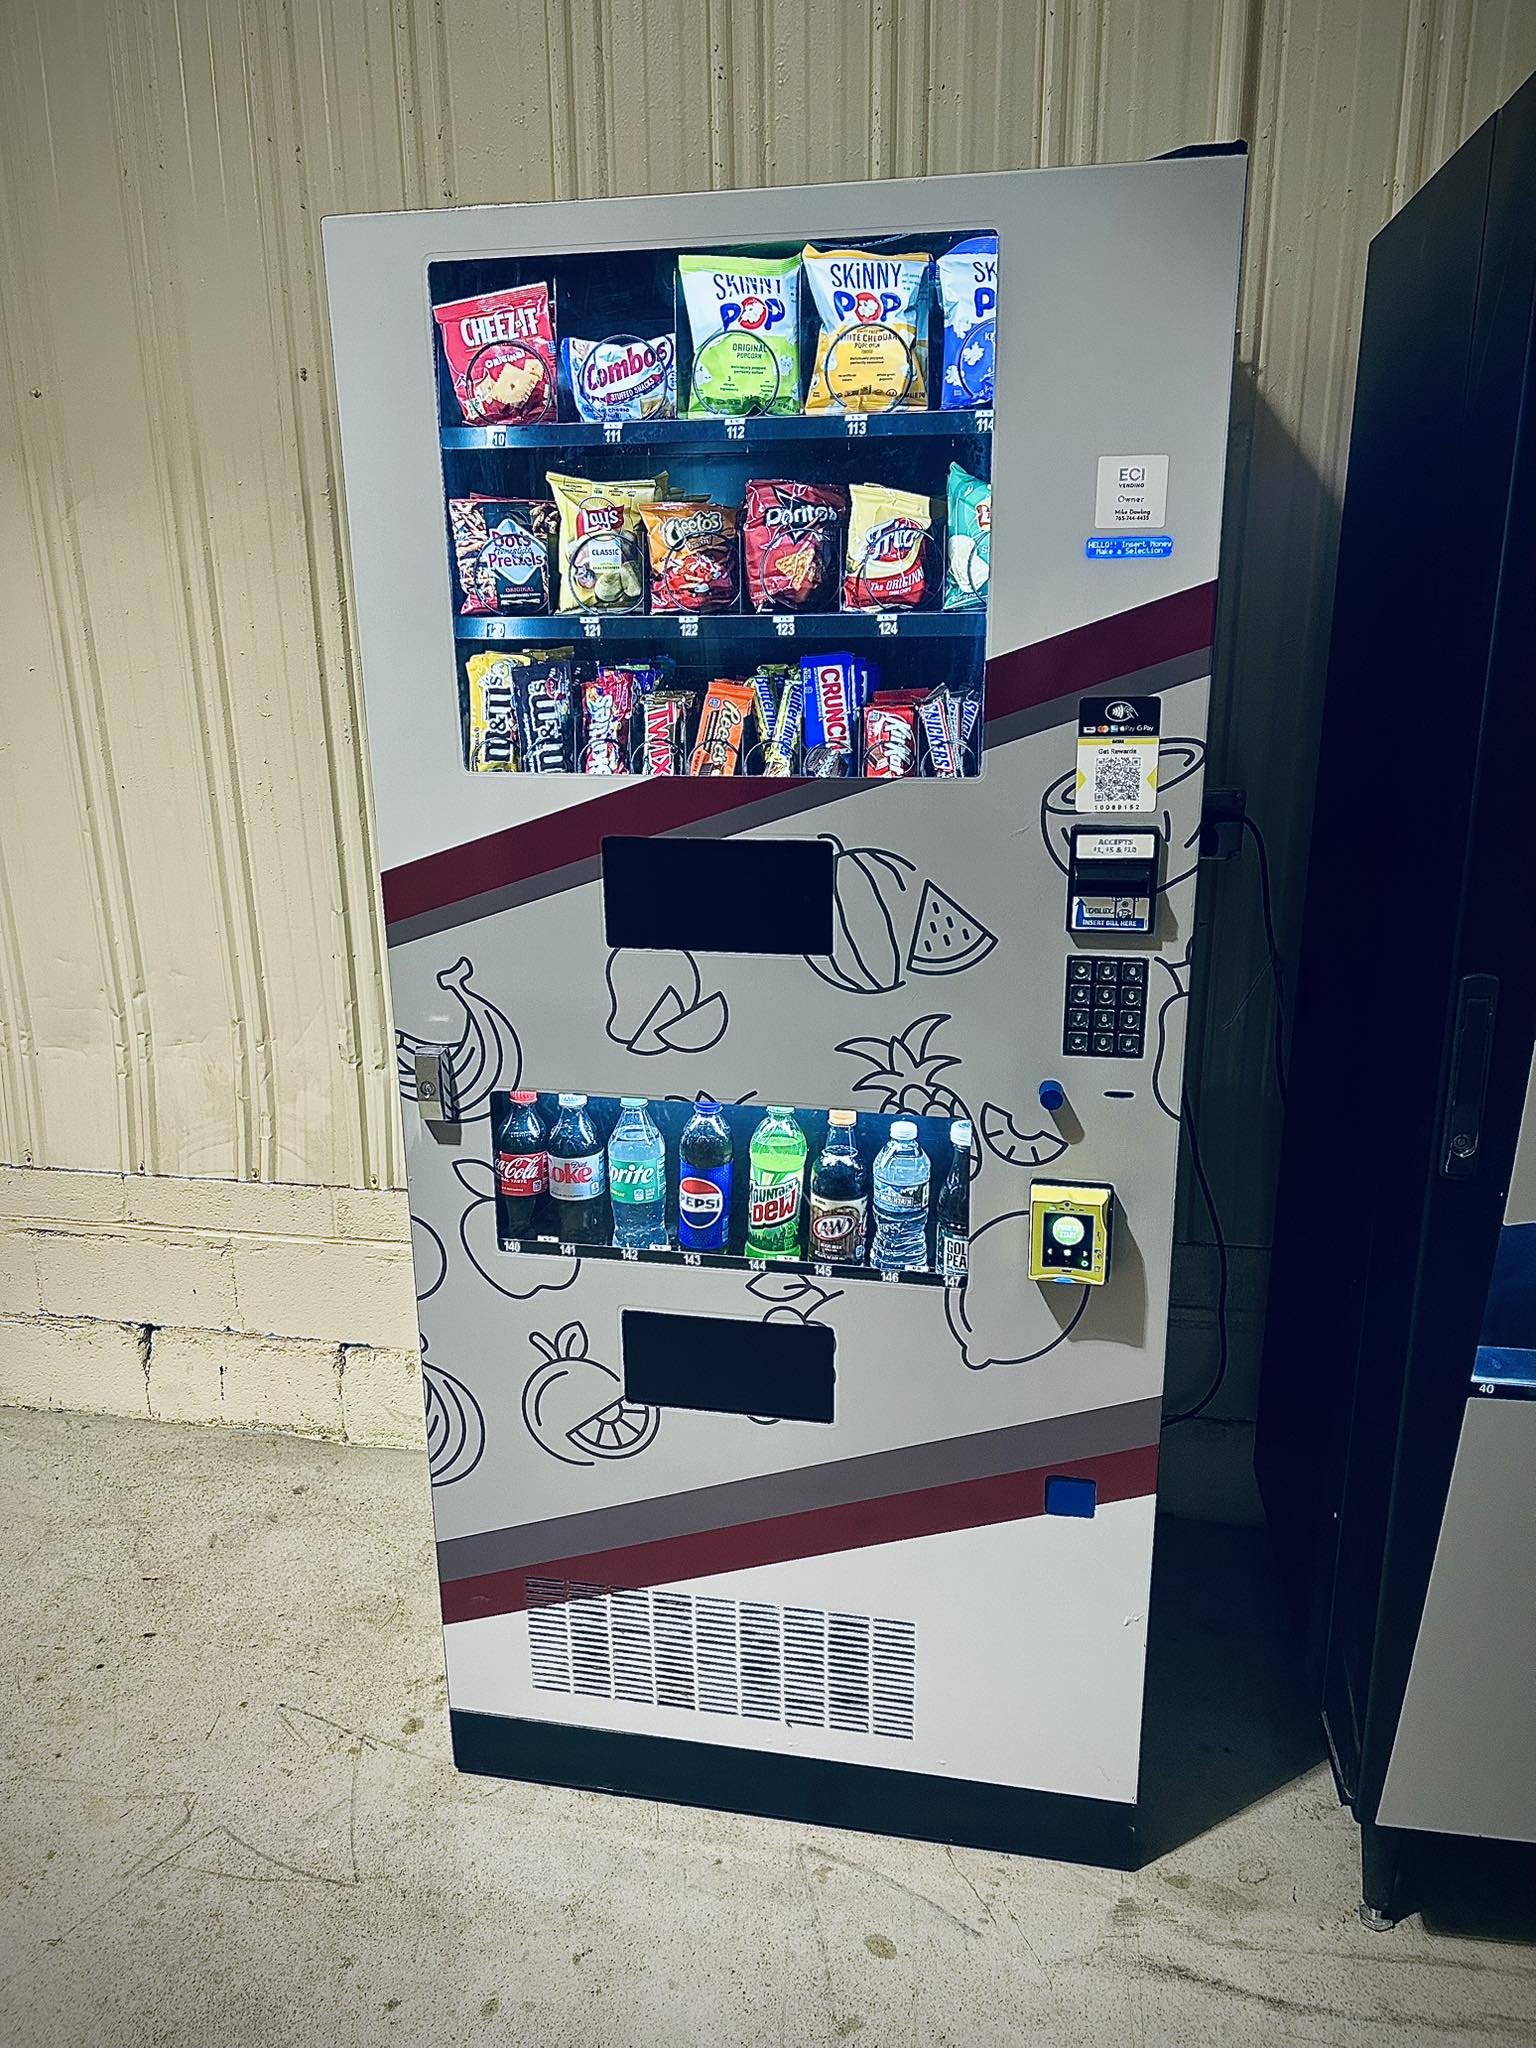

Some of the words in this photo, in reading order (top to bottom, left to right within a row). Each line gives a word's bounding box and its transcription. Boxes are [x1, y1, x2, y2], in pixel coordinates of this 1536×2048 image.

[720, 296, 786, 332] POP
[833, 291, 902, 324] POP
[732, 343, 768, 352] ORIGINAL
[587, 341, 668, 391] Combos
[610, 389, 634, 402] STUFFED
[726, 425, 745, 439] 112
[848, 422, 867, 435] 113
[604, 430, 622, 443] 111
[1119, 468, 1145, 481] ECI
[1118, 495, 1145, 503] Owner
[582, 506, 619, 533] Lay's
[766, 505, 838, 526] Doritos
[665, 512, 721, 548] Cheetos
[491, 531, 532, 548] Dot's
[488, 552, 543, 568] Pretzels
[885, 566, 924, 590] ORIGINA
[584, 624, 600, 637] 121
[680, 623, 698, 637] 122
[776, 622, 795, 636] 123
[879, 622, 898, 635] 124
[820, 668, 850, 750] CRUNCH
[924, 703, 950, 768] SNICKERS
[551, 1163, 593, 1184] oke
[609, 1163, 655, 1185] prite
[681, 1192, 721, 1209] PEPSI
[503, 1241, 521, 1252] 140
[560, 1245, 576, 1256] 141
[621, 1250, 638, 1261] 142
[683, 1255, 701, 1266] 143
[749, 1260, 766, 1271] 144
[814, 1265, 832, 1277] 145
[881, 1272, 899, 1283] 146
[943, 1276, 961, 1287] 147
[1479, 1384, 1495, 1394] 40
